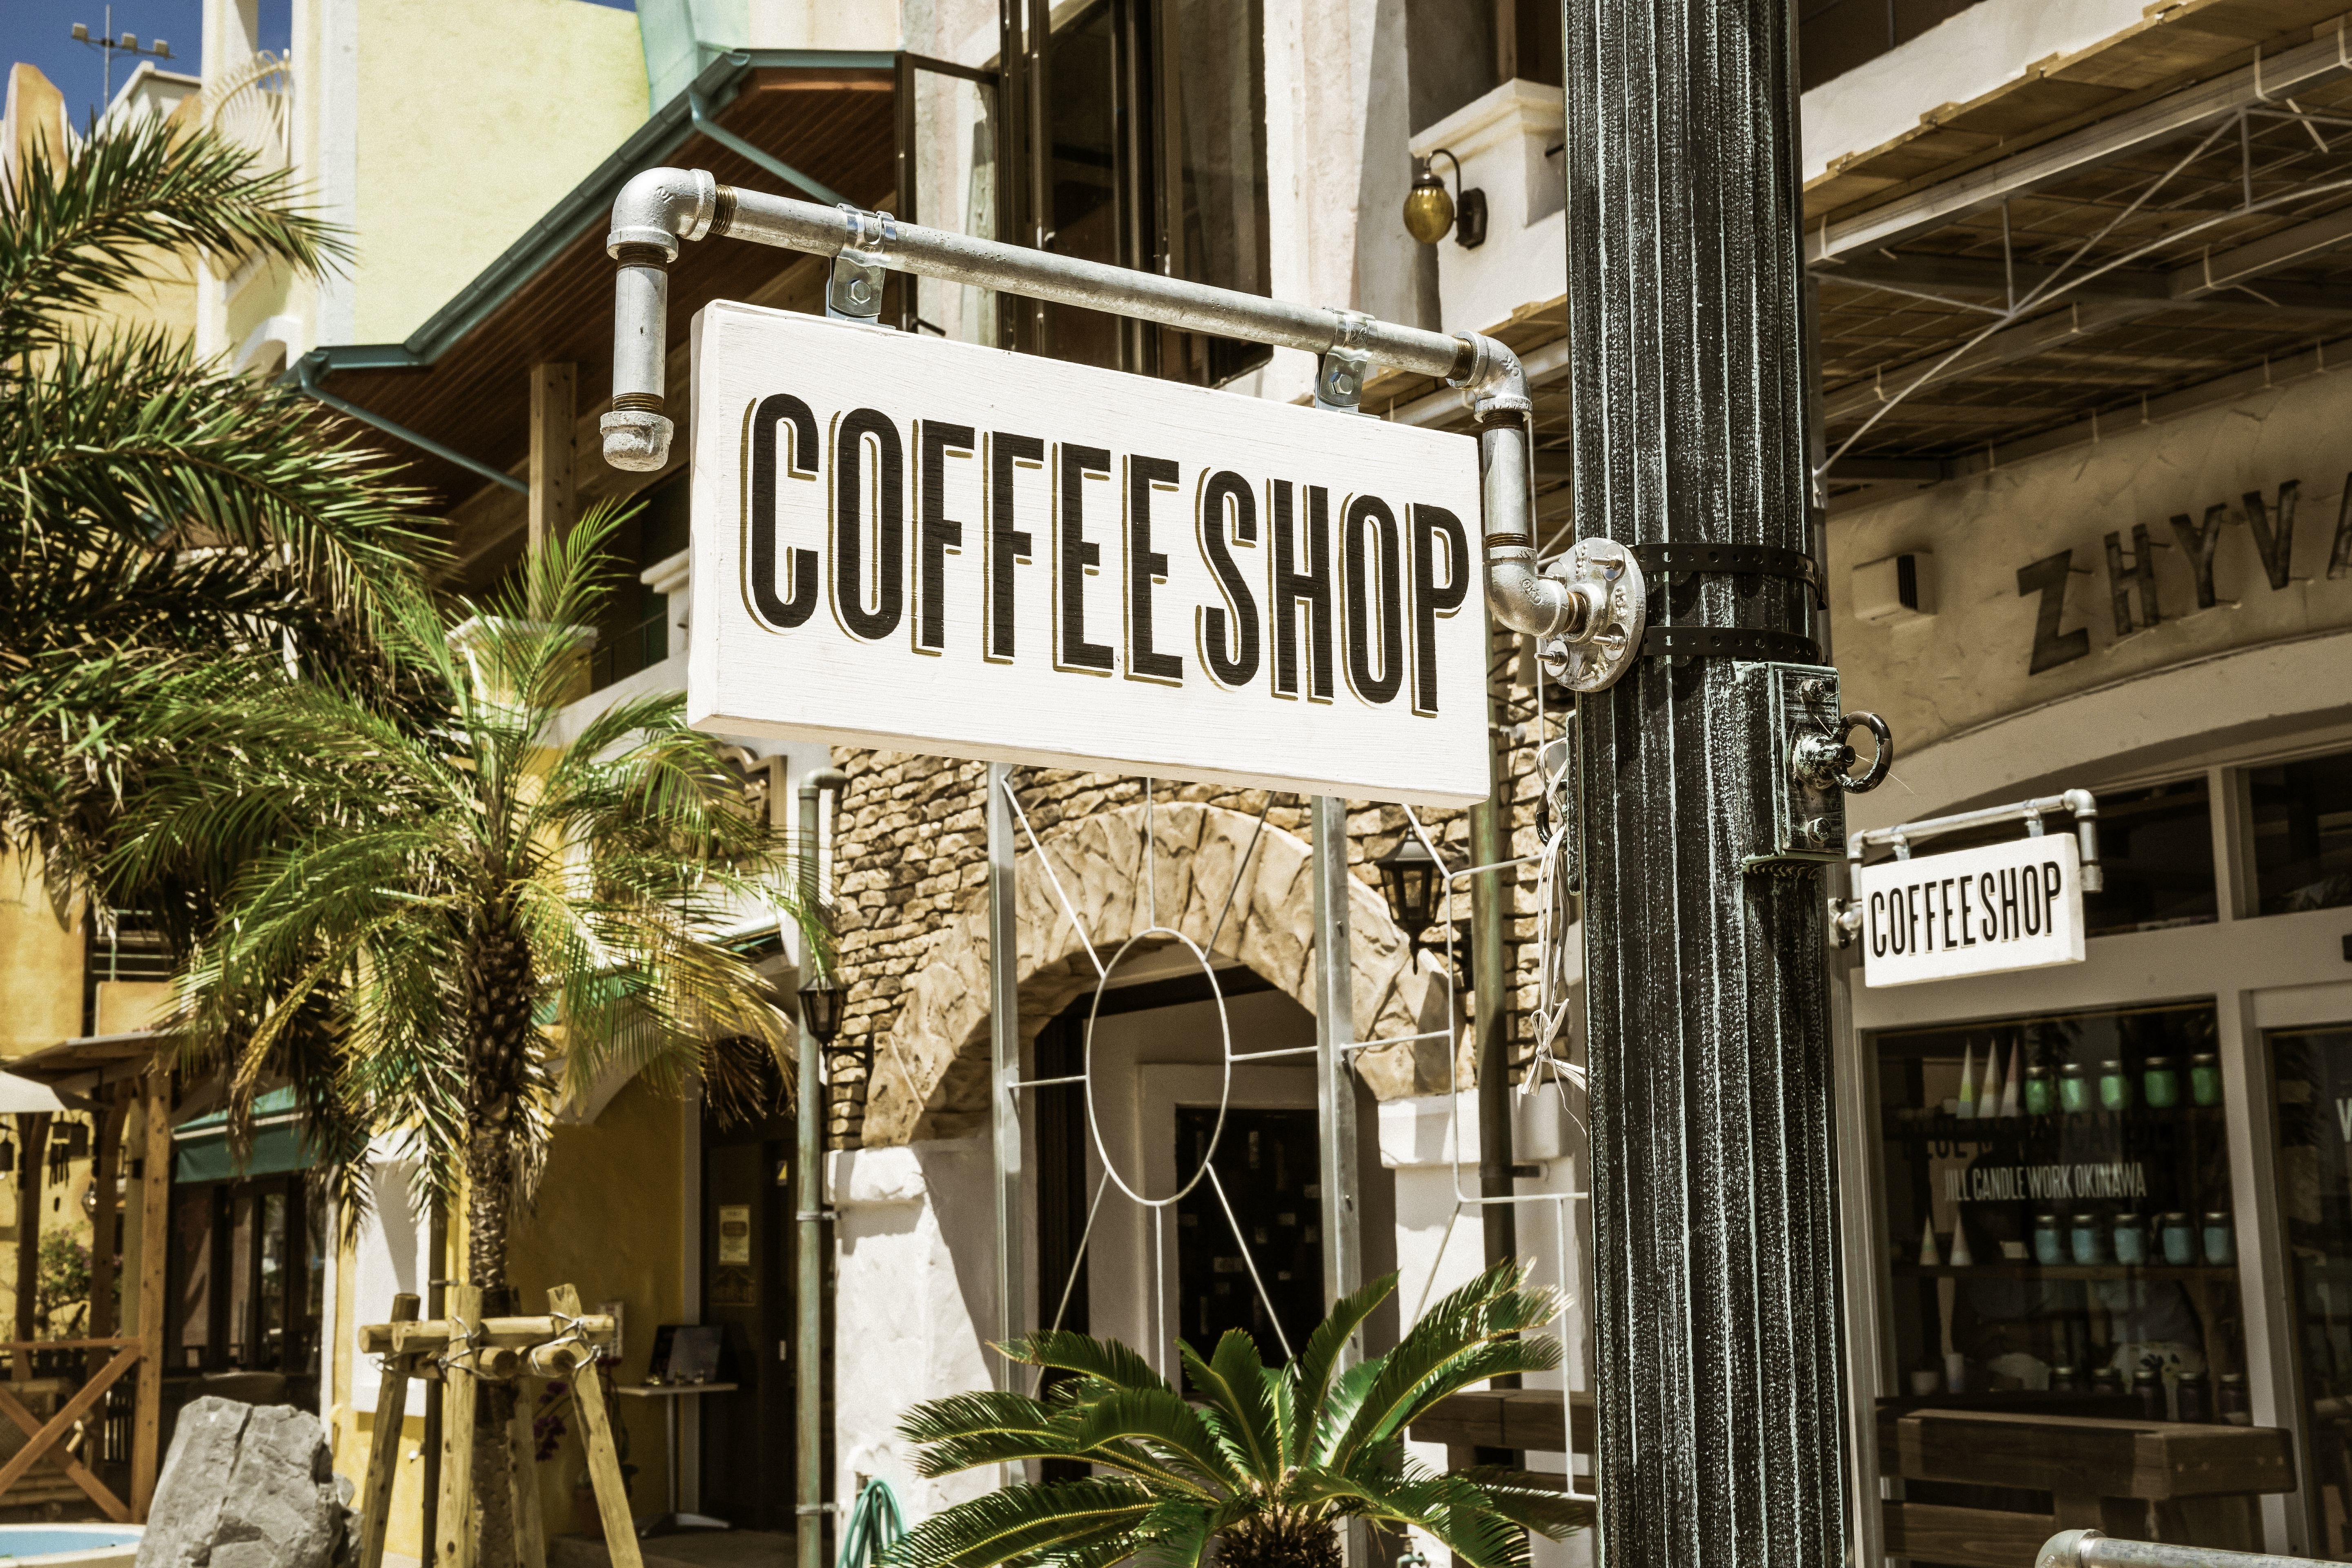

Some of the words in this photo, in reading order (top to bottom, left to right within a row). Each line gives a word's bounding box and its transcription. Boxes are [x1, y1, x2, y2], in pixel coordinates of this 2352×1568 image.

[1945, 1169, 1971, 1201] JILL
[1972, 1167, 2026, 1200] CANDLE
[2026, 1164, 2073, 1199] WORK
[2074, 1162, 2147, 1198] OKINAWA
